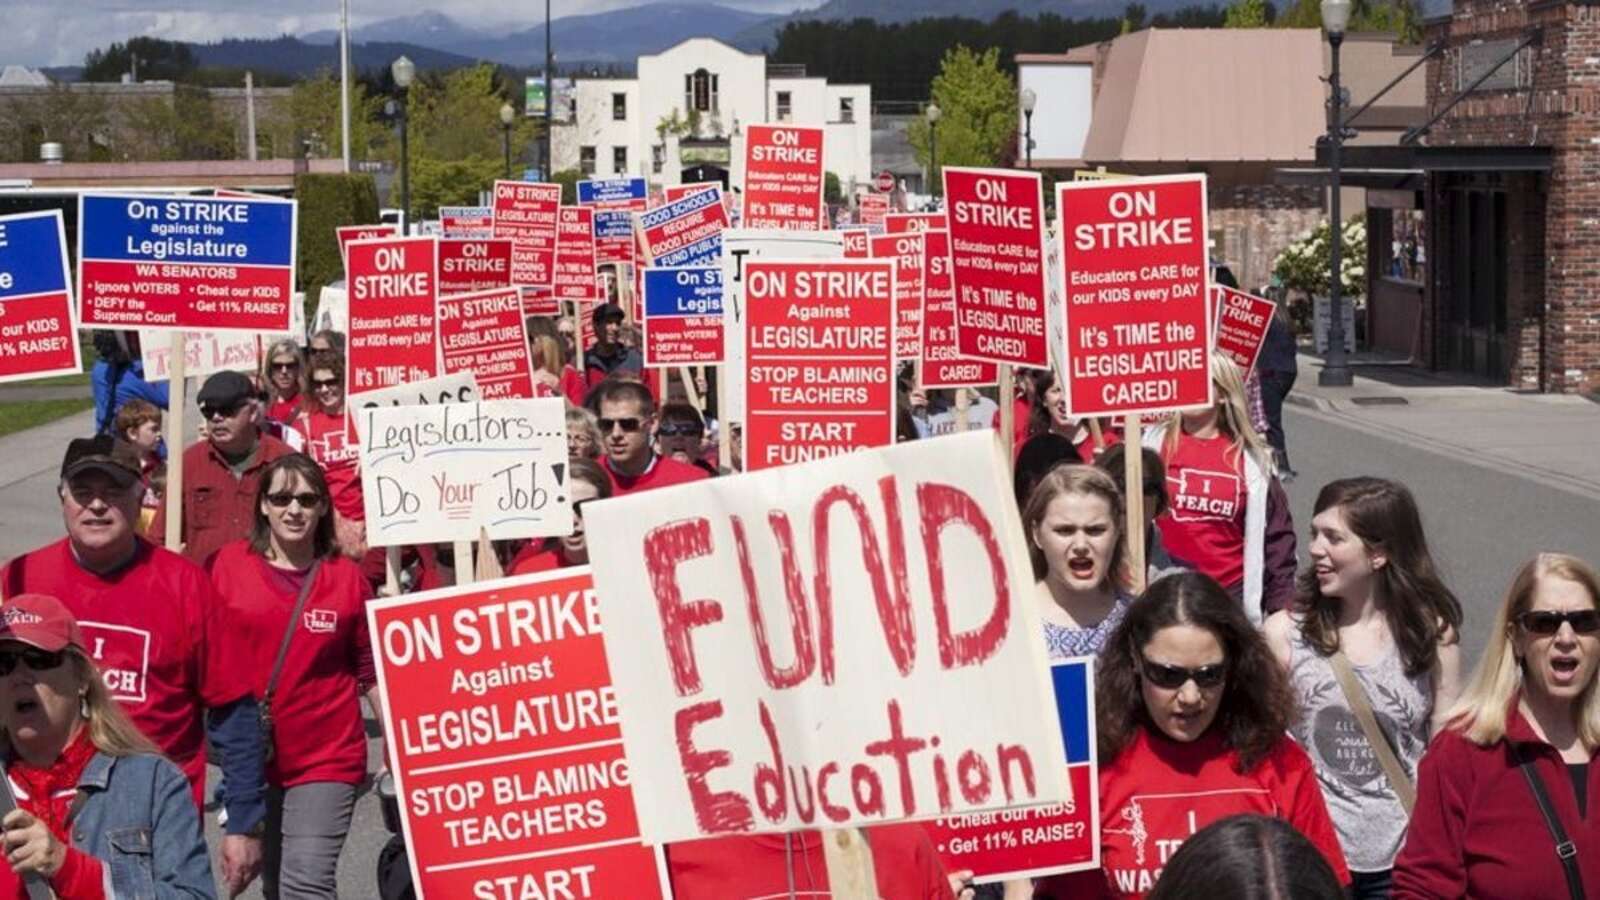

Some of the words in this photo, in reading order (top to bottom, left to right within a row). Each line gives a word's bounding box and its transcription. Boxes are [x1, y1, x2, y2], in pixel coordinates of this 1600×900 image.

[772, 130, 799, 146] ON
[752, 145, 817, 163] STRIKE
[497, 185, 515, 198] ON
[517, 187, 558, 200] STRIKE
[975, 179, 1007, 202] ON
[128, 201, 158, 219] On
[165, 202, 248, 223] STRIKE
[642, 209, 671, 227] GOOD
[672, 191, 716, 216] SCHOOLS
[768, 203, 795, 217] TIME
[797, 204, 814, 217] the
[1109, 191, 1156, 218] ON
[496, 210, 555, 221] LEGISLATURE
[562, 211, 578, 222] ON
[663, 212, 705, 236] REQUIRE
[955, 201, 1033, 229] STRIKE
[151, 222, 200, 236] against
[203, 223, 224, 235] the
[495, 227, 516, 235] STOP
[518, 229, 555, 238] BLAMING
[651, 239, 681, 256] GOOD
[682, 219, 724, 243] FUNDING
[1074, 217, 1192, 251] STRIKE
[128, 236, 248, 259] Legislature
[462, 243, 488, 257] ON
[896, 239, 921, 253] ON
[954, 239, 996, 254] Educators
[997, 244, 1023, 257] CARE
[1025, 246, 1038, 258] for
[375, 248, 405, 271] ON
[443, 258, 506, 272] STRIKE
[661, 249, 689, 266] FUND
[956, 257, 970, 267] our
[971, 257, 993, 270] KIDS
[995, 261, 1018, 275] every
[1019, 262, 1039, 275] DAY
[135, 264, 159, 277] WA
[161, 265, 237, 279] SENATORS
[677, 271, 700, 285] On
[1071, 268, 1137, 285] Educators
[1140, 266, 1179, 281] CARE
[1181, 265, 1200, 278] for
[94, 281, 130, 294] Ignore
[132, 282, 180, 295] VOTERS
[197, 284, 230, 297] Cheat
[231, 287, 251, 297] our
[252, 286, 280, 298] KIDS
[355, 272, 429, 299] STRIKE
[749, 271, 787, 298] ON
[794, 271, 888, 299] STRIKE
[1072, 293, 1095, 304] our
[1098, 288, 1131, 303] KIDS
[1133, 288, 1169, 303] every
[1172, 283, 1200, 298] DAY
[94, 297, 125, 309] DEFY
[127, 298, 145, 310] the
[196, 301, 218, 313] Get
[221, 302, 241, 313] 11%
[243, 303, 286, 315] RAISE?
[439, 303, 460, 320] ON
[463, 294, 518, 317] STRIKE
[961, 284, 980, 304] It's
[982, 287, 1013, 308] TIME
[1016, 291, 1037, 312] the
[1230, 295, 1253, 311] ON
[93, 309, 143, 323] Supreme
[145, 311, 177, 323] Court
[351, 318, 392, 330] Educators
[393, 315, 418, 328] CARE
[420, 314, 432, 326] for
[462, 315, 498, 330] Against
[787, 304, 851, 321] Against
[960, 307, 1043, 336] LEGISLATURE
[1223, 304, 1264, 327] TRIKE
[26, 318, 59, 334] KIDS
[683, 330, 718, 339] VOTERS
[1080, 326, 1108, 348] It's
[1113, 322, 1160, 346] TIME
[1165, 321, 1195, 341] the
[19, 336, 68, 354] RAISE?
[352, 337, 366, 347] our
[367, 334, 388, 346] KIDS
[389, 335, 412, 348] every
[413, 332, 433, 344] DAY
[443, 325, 522, 349] LEGISLATURE
[751, 326, 887, 349] LEGISLATURE
[977, 333, 1027, 358] CARED!
[656, 343, 679, 352] DEFY
[446, 355, 474, 369] STOP
[476, 349, 525, 364] BLAMING
[1074, 348, 1203, 378] LEGISLATURE
[355, 367, 373, 386] It's
[375, 366, 406, 385] TIME
[750, 366, 799, 383] STOP
[803, 366, 887, 383] BLAMING
[939, 364, 982, 381] CARED!
[769, 387, 868, 404] TEACHERS
[1102, 380, 1178, 405] CARED!
[781, 422, 856, 441] START
[377, 476, 420, 517] Do
[432, 472, 482, 511] Your
[1203, 479, 1211, 494] I
[1175, 494, 1234, 516] TEACH
[643, 475, 1011, 697] FUND
[383, 614, 443, 666] ON
[453, 588, 603, 656] STRIKE
[93, 638, 104, 659] I
[451, 655, 555, 696] Against
[401, 685, 621, 756] LEGISLATURE
[675, 698, 1036, 832] Education
[411, 780, 485, 817] STOP
[492, 758, 631, 806] BLAMING
[444, 799, 607, 848] TEACHERS
[1002, 809, 1029, 822] our
[950, 837, 979, 855] Get
[984, 831, 1017, 849] 11%
[1021, 822, 1085, 845] RAISE?
[473, 864, 596, 900] START
